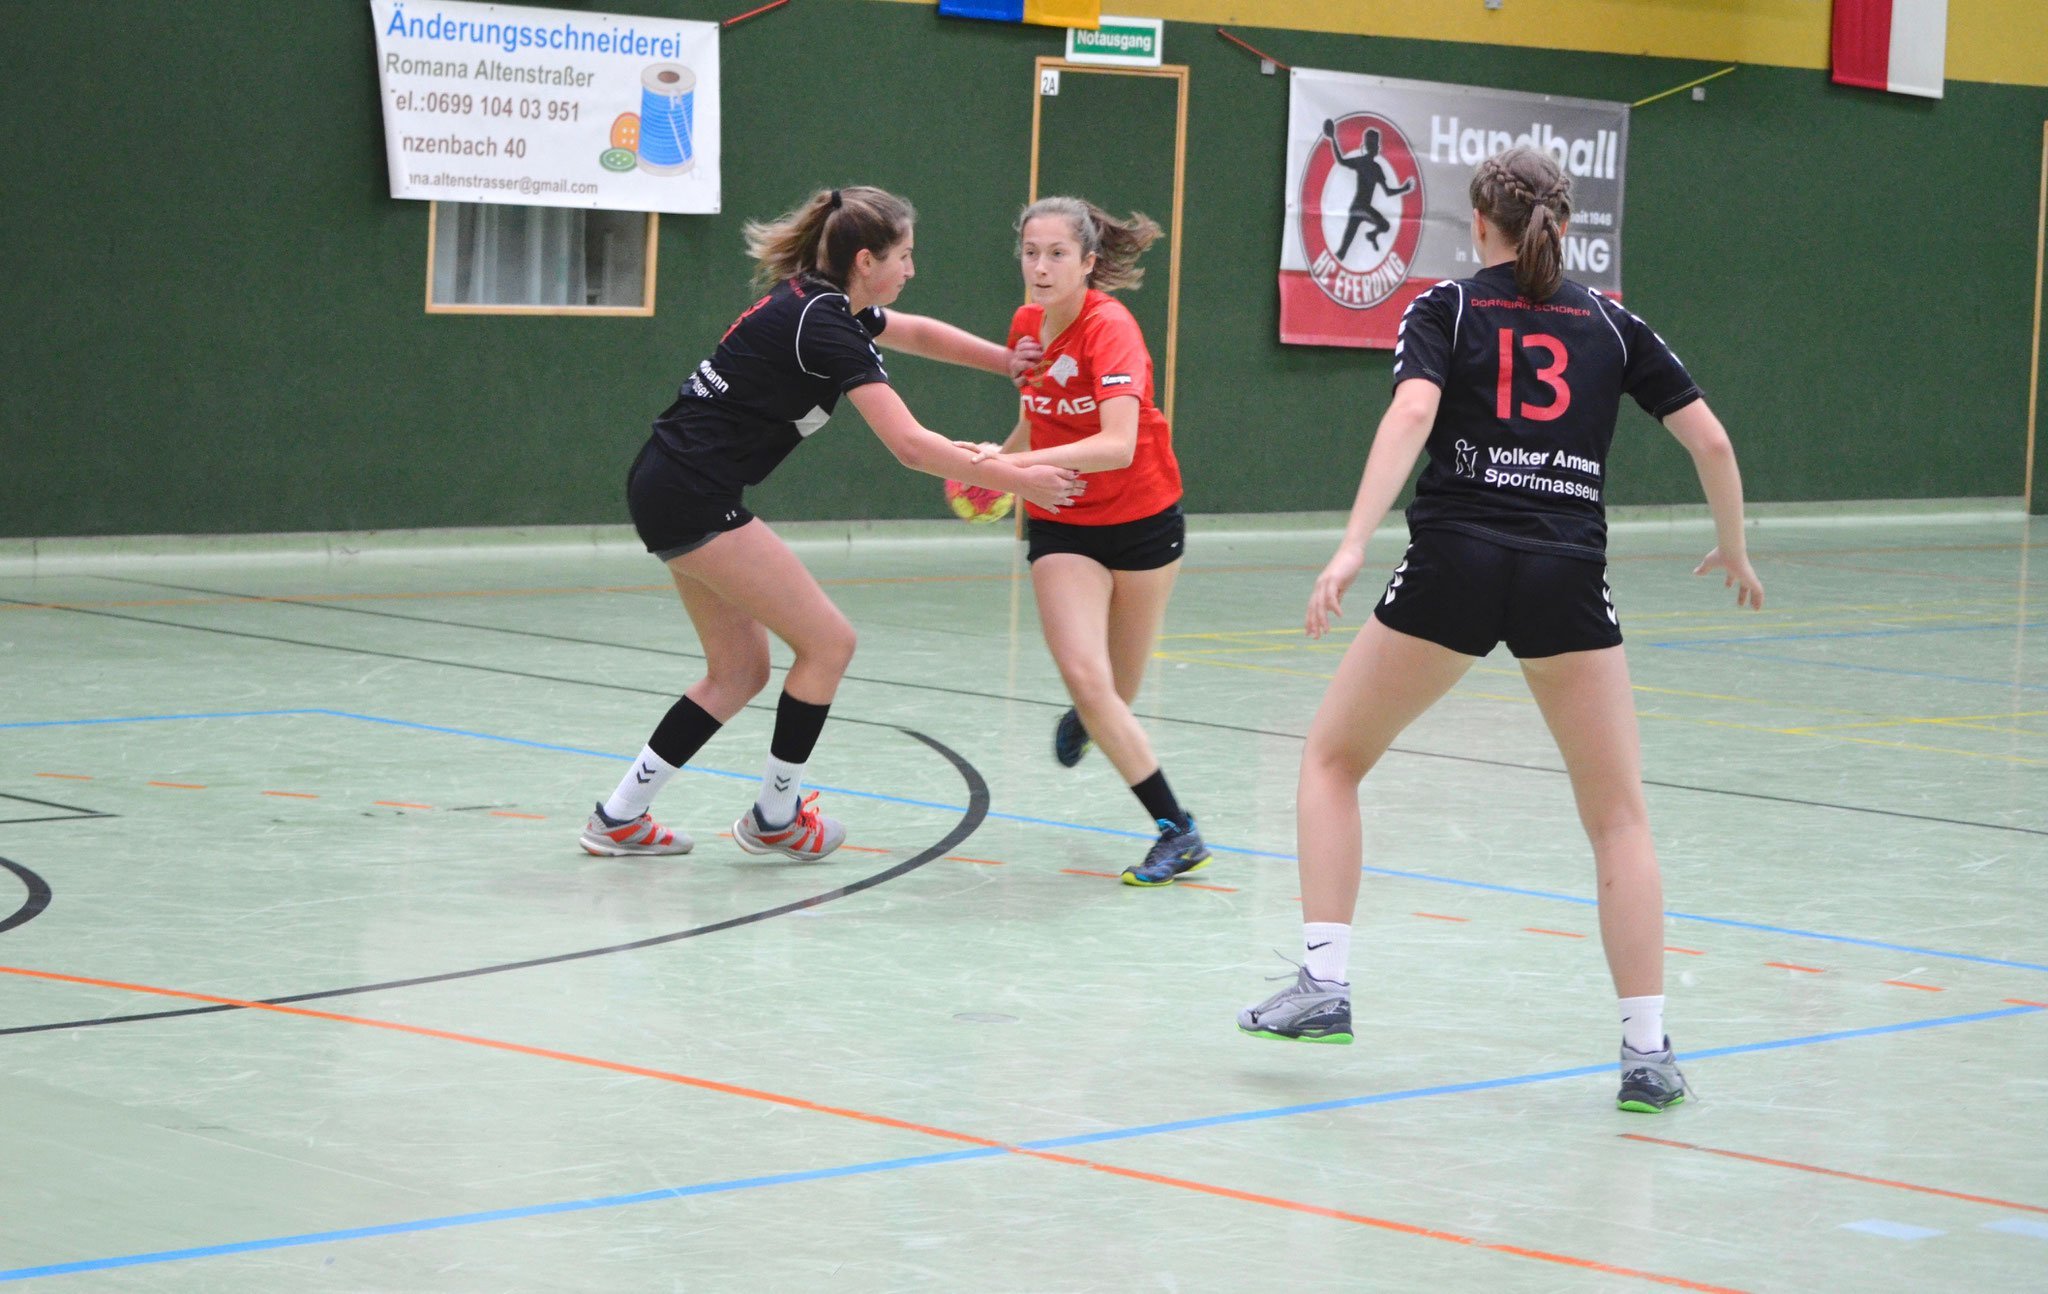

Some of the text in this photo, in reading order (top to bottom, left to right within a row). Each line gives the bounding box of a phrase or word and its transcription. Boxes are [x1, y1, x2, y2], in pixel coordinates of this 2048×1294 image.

[387, 2, 682, 58] Änderungsschneiderei
[1077, 30, 1152, 51] Notausgang
[385, 53, 595, 88] Romana Altenstraßer
[1043, 77, 1055, 94] 2A
[391, 89, 579, 122] el.:0699 104 03 951
[402, 134, 527, 158] nzenbach 40
[1430, 115, 1618, 179] Handball
[1312, 249, 1406, 303] HC EFERDING
[1496, 327, 1571, 422] 13
[1057, 395, 1097, 415] AG
[1488, 446, 1549, 467] Volker
